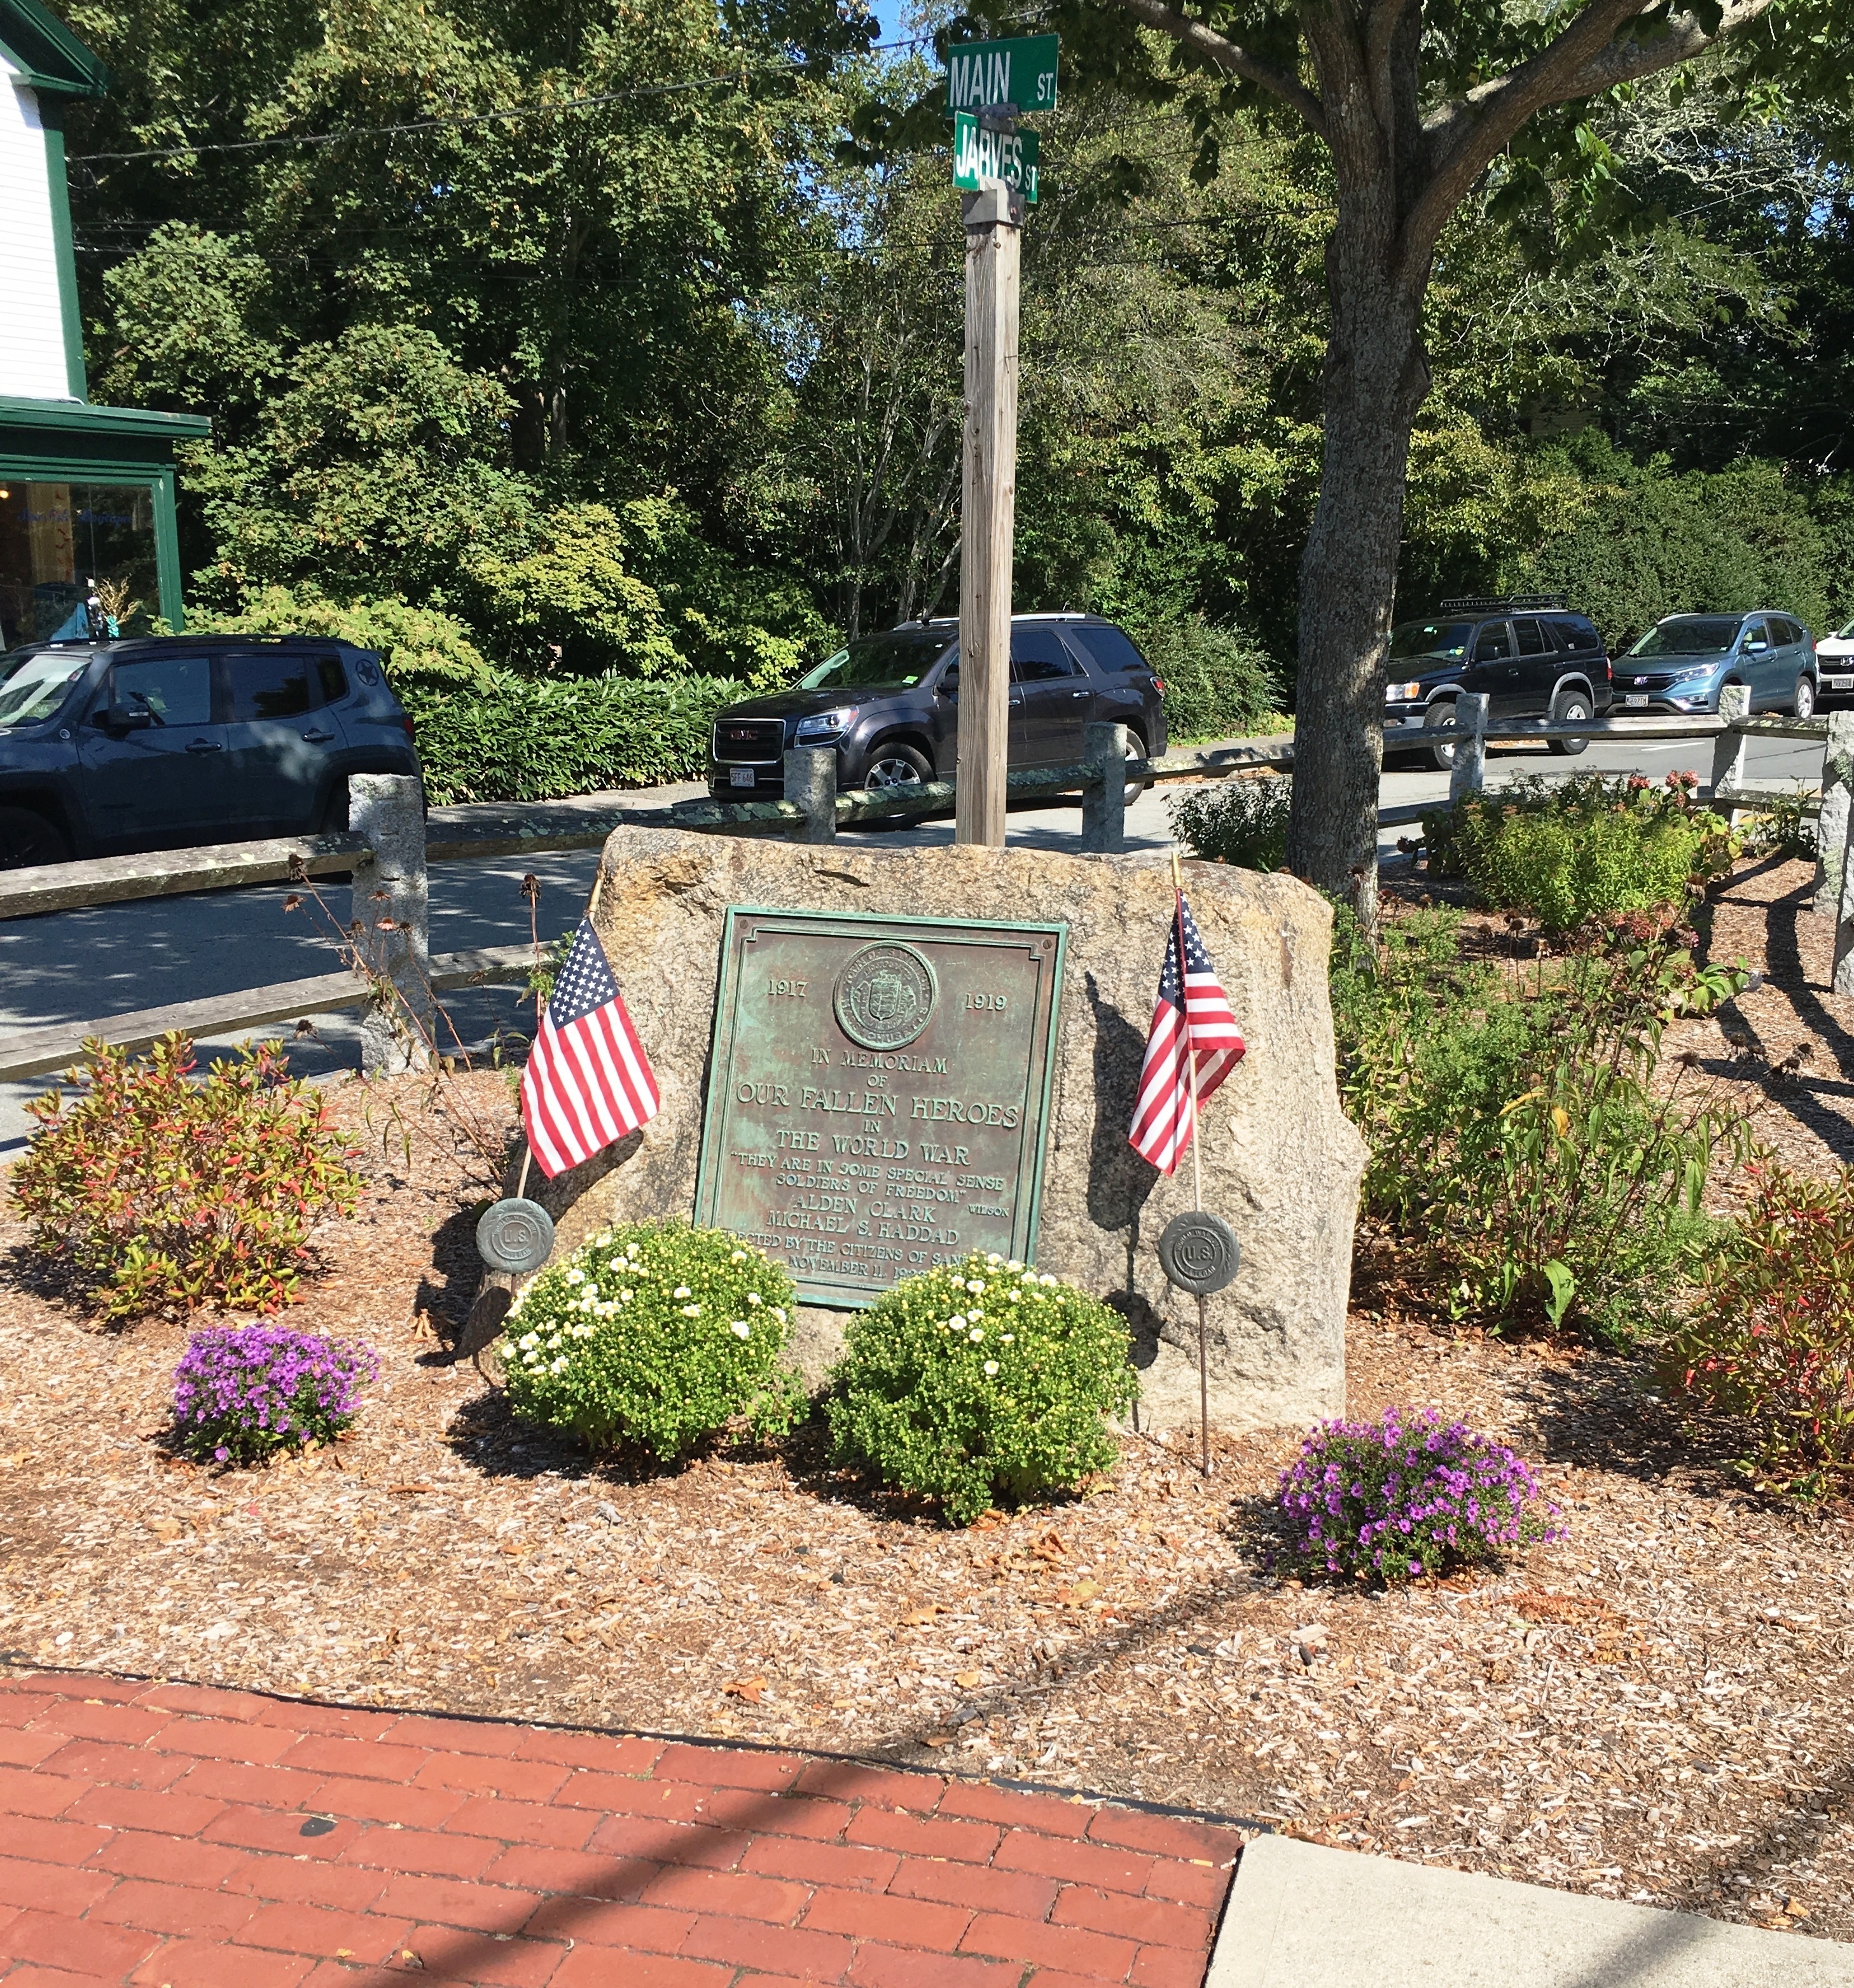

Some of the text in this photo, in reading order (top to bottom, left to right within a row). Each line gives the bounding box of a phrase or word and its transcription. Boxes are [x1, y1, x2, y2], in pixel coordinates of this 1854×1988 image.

[950, 51, 1053, 107] MAIN ST
[956, 124, 1037, 191] JARVES ST
[730, 730, 758, 740] GMC
[768, 979, 809, 997] 1917
[965, 992, 1007, 1011] 1919
[811, 1047, 948, 1074] IN MEMORIAM
[867, 1074, 888, 1088] OF
[737, 1082, 1019, 1128] OUR FALLEN HEROES
[864, 1120, 881, 1133] IN
[776, 1129, 971, 1166] THE WORLD WAR
[776, 1173, 851, 1192] SOLDIERS
[858, 1180, 878, 1194] OF
[780, 1157, 812, 1172] ARE
[816, 1159, 834, 1174] IN
[838, 1163, 880, 1178] SOME
[887, 1167, 948, 1185] SPECIAL
[956, 1174, 1005, 1191] SENSE
[792, 1194, 936, 1224] ALDEN CLARK
[967, 1203, 1010, 1217] WILSON
[504, 1229, 529, 1243] U.S.
[766, 1210, 960, 1245] MICHAEL S. HADDAD
[785, 1236, 804, 1250] BY
[808, 1238, 836, 1254] THE
[840, 1243, 903, 1262] CITIZENS
[908, 1250, 928, 1265] OF
[1186, 1245, 1213, 1260] U.S.
[789, 1255, 868, 1276] NOVEMBER
